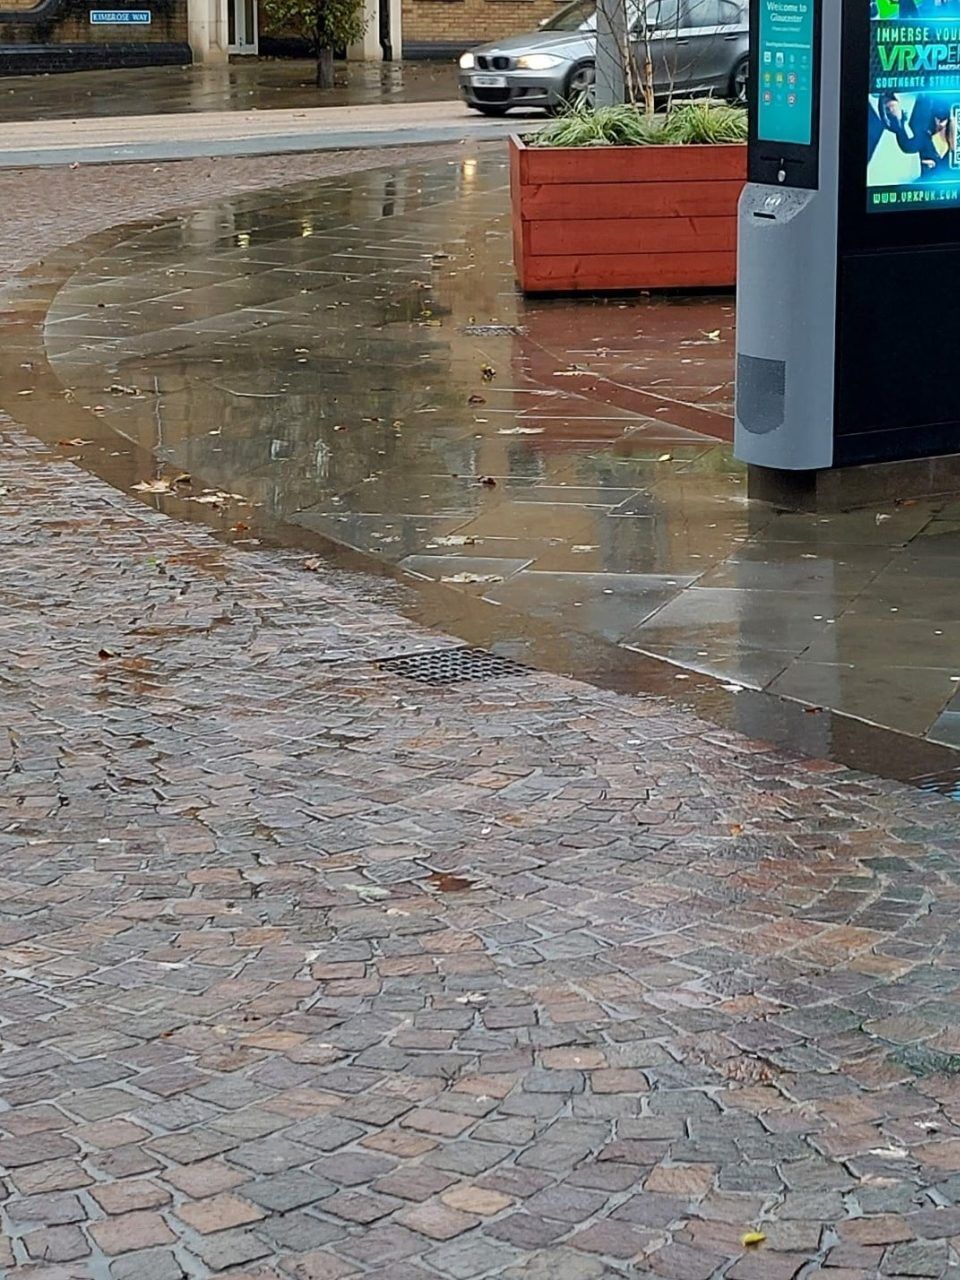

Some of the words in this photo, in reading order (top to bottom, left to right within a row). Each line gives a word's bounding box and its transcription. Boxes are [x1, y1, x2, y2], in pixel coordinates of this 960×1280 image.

[766, 1, 798, 12] Welcome
[132, 13, 148, 21] WAY
[877, 27, 929, 42] IMMERSE
[875, 76, 926, 89] SOUTHGATE
[929, 75, 960, 87] STREET
